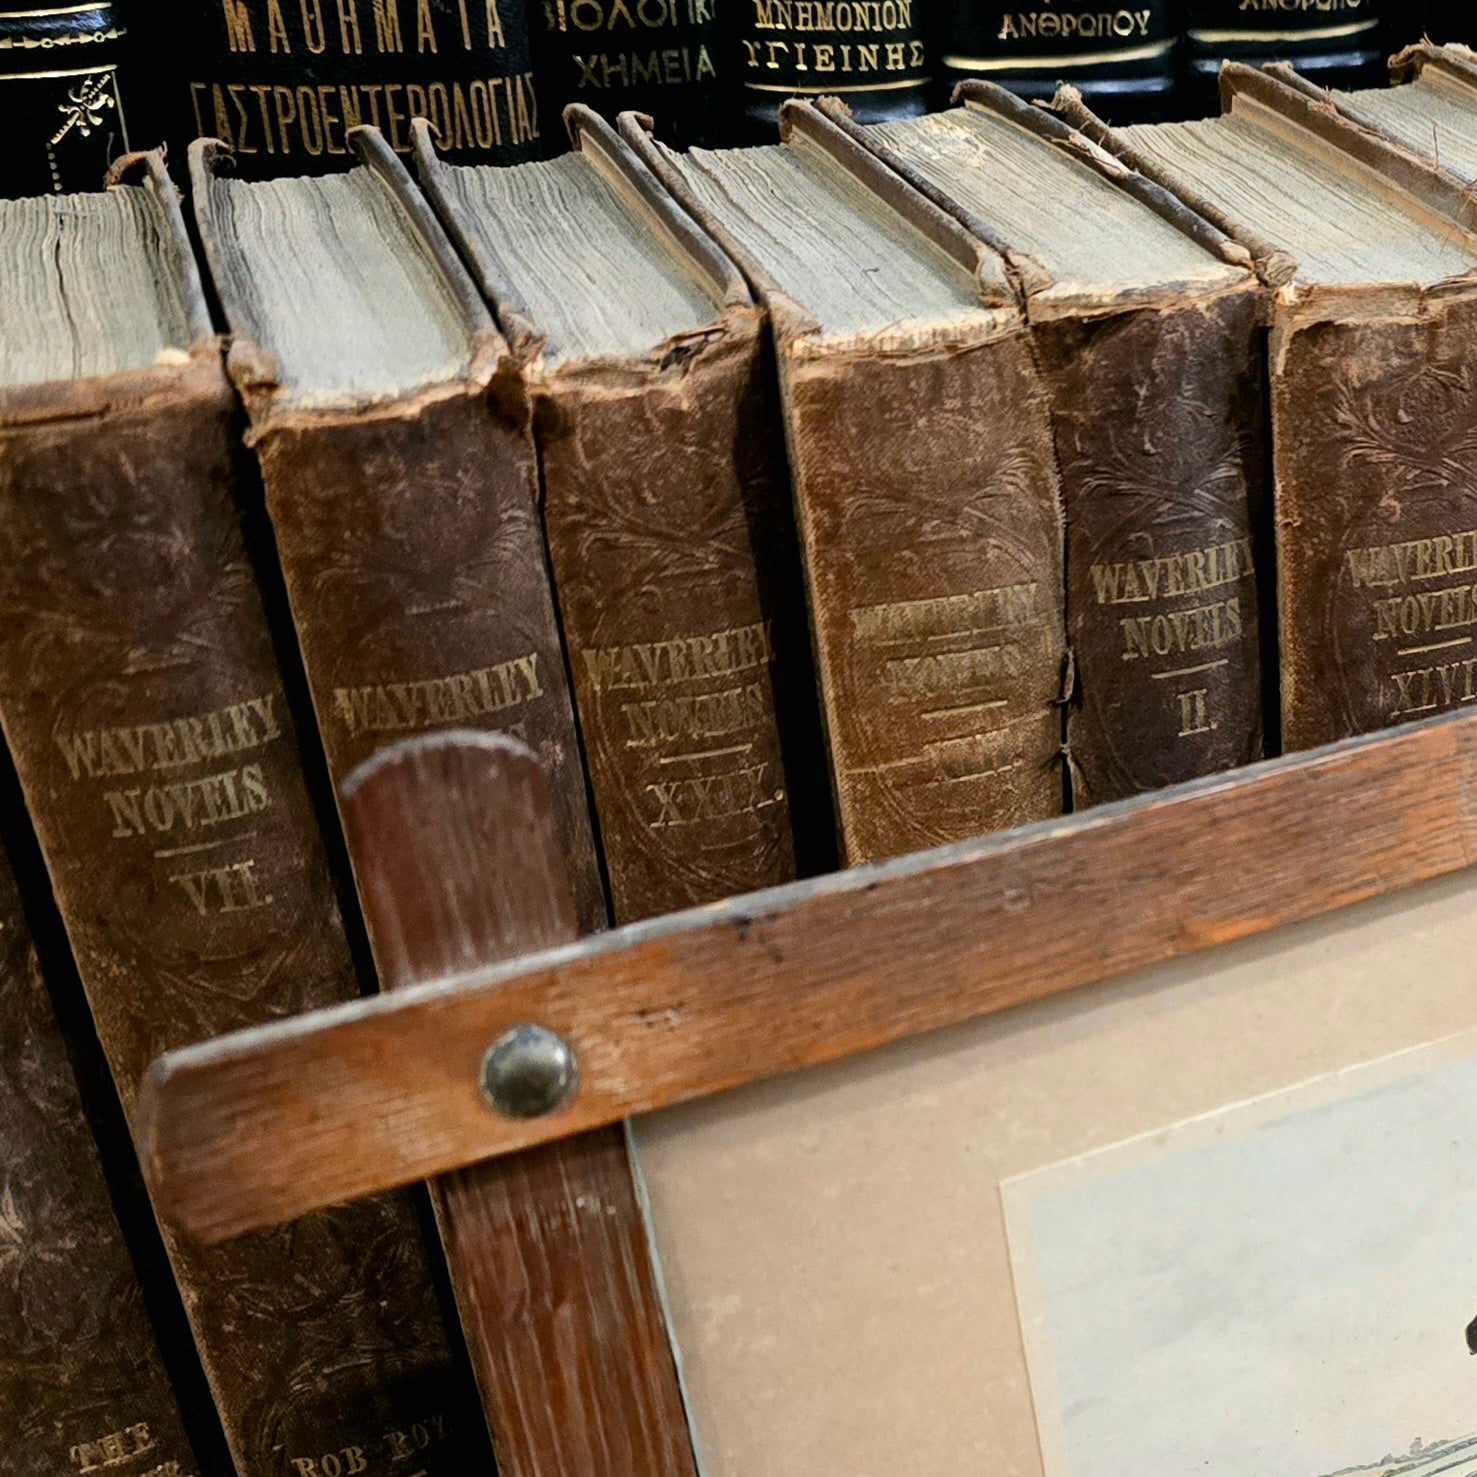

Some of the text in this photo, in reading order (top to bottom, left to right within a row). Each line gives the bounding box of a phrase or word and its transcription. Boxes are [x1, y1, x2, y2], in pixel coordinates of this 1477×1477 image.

[741, 39, 925, 72] ΥΓΙΕΙΝΗΣ
[997, 9, 1152, 40] ΑΝΘΡΩΠΟΥ
[572, 44, 718, 89] ΧΗΜΕΙΑ
[1090, 537, 1256, 604] WAVERLEY
[1119, 597, 1243, 661] NOVELS
[333, 652, 543, 738] WAVERLEY
[54, 694, 281, 781] WAVERLEY
[103, 763, 272, 838] NOVELS
